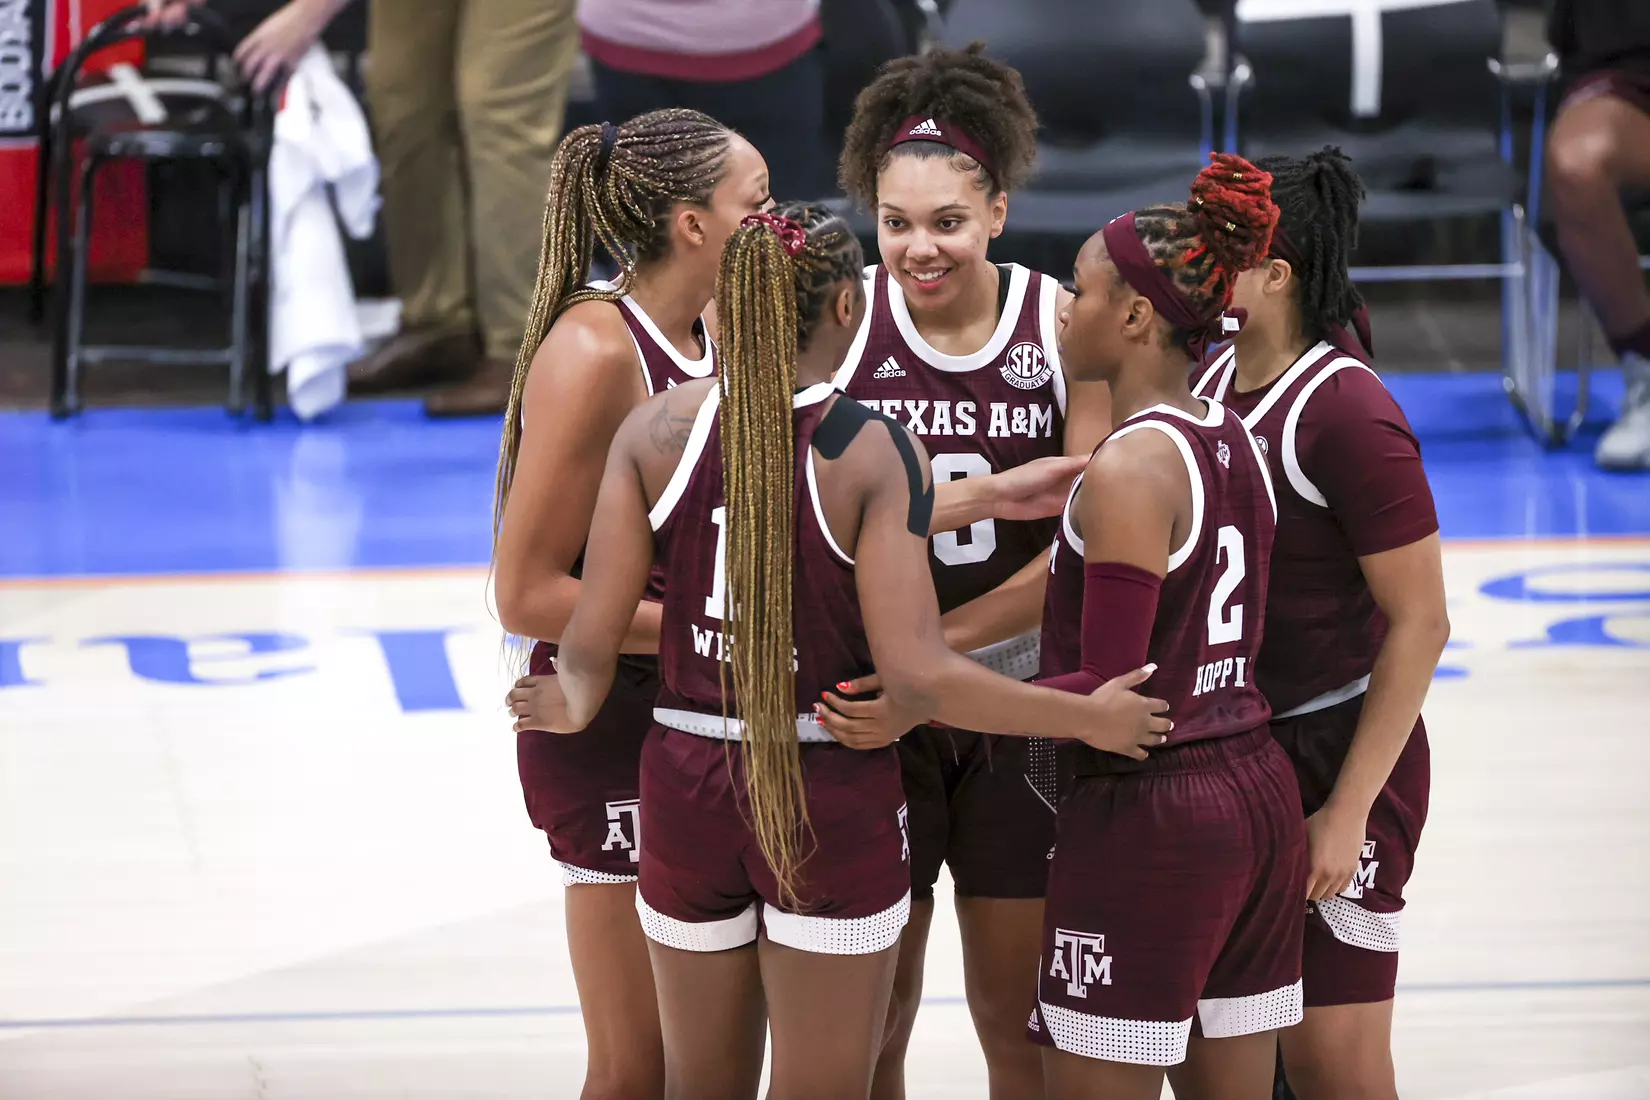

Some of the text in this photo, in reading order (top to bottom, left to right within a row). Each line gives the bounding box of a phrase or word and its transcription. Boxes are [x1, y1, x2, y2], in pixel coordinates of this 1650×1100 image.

[909, 128, 942, 136] adidas
[873, 368, 907, 379] adidas
[1010, 344, 1044, 378] SEC
[1004, 373, 1047, 389] GRADUATE
[857, 400, 1053, 438] EXAS A&M
[1207, 525, 1246, 646] 2
[1192, 656, 1252, 697] HOPPI
